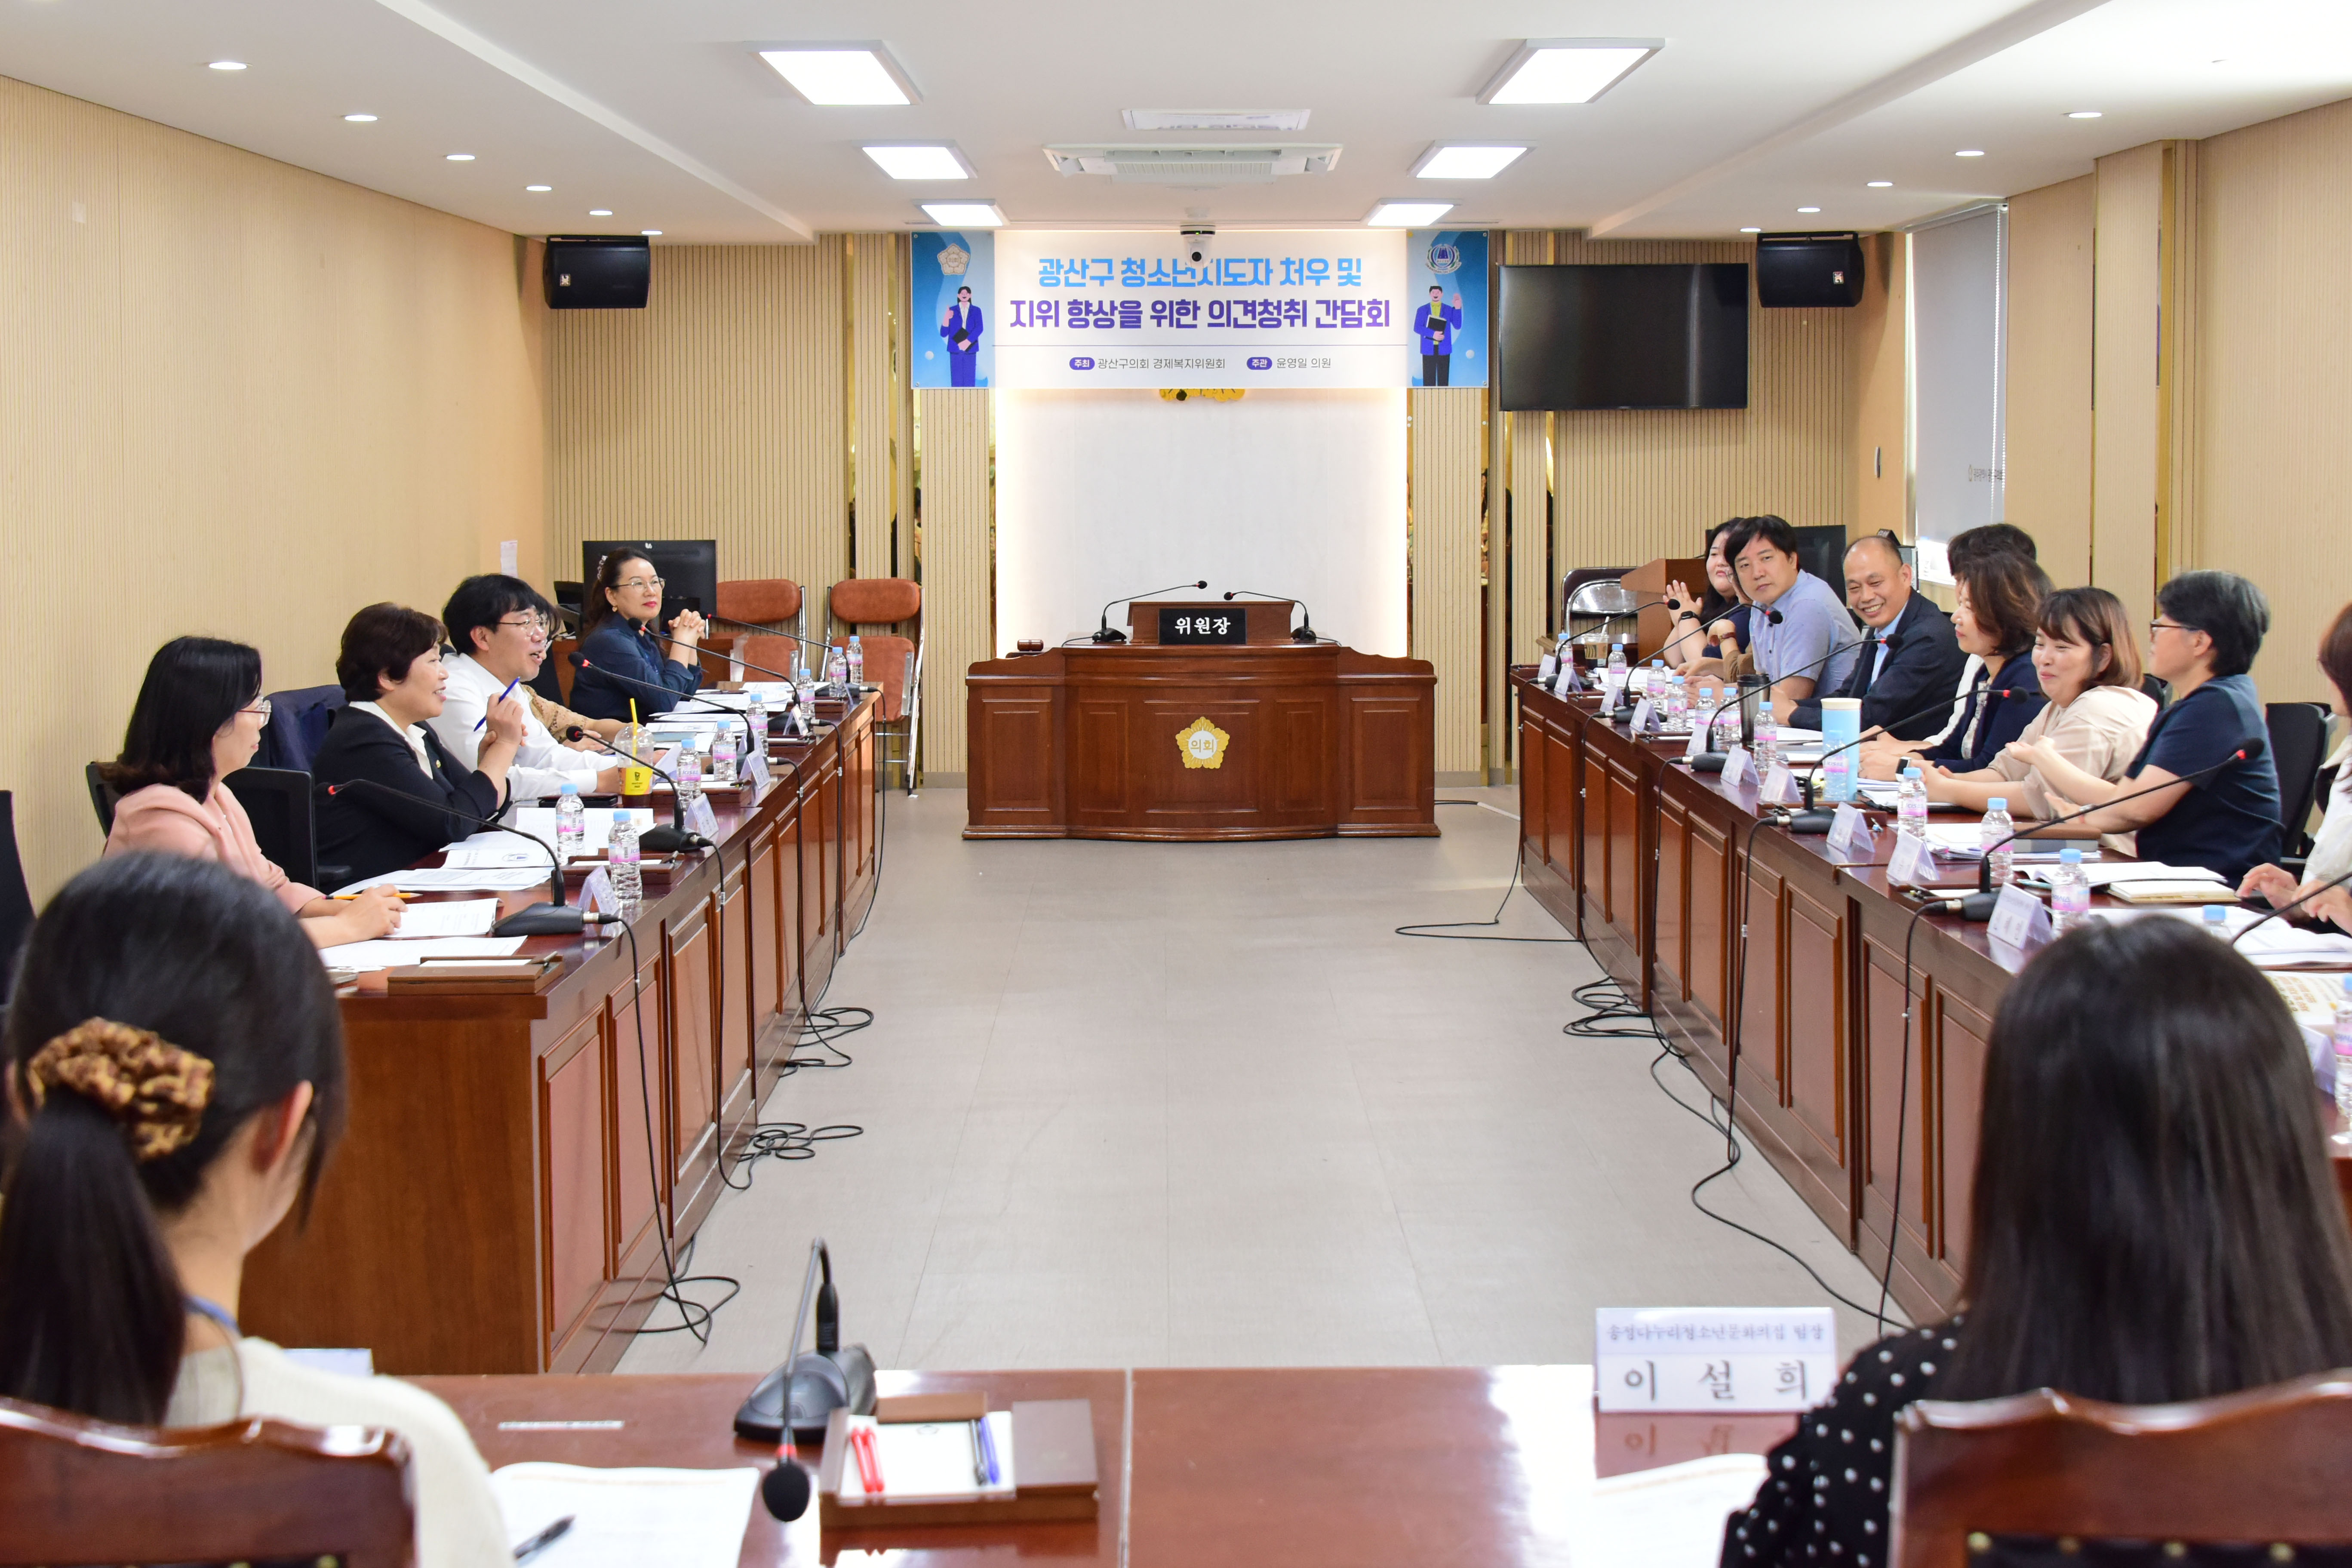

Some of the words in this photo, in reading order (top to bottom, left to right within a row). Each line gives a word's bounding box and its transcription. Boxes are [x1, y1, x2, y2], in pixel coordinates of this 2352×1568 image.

[1039, 258, 1114, 287] 광산구
[1279, 257, 1330, 286] 처우
[1337, 258, 1362, 286] 및
[1010, 300, 1060, 328] 지위
[1067, 299, 1143, 329] 향상을
[1150, 299, 1201, 329] 위한
[1207, 298, 1307, 329] 의견청취
[1315, 298, 1390, 329] 간담회
[1074, 359, 1090, 368] 주최
[1098, 358, 1149, 369] 광산구의회
[1153, 358, 1226, 369] 경제복지위원회
[1251, 359, 1268, 368] 주관
[1276, 357, 1307, 369] 윤영일
[1311, 357, 1331, 369] 의원
[1174, 617, 1231, 635] 위원장
[1190, 739, 1214, 753] 의회
